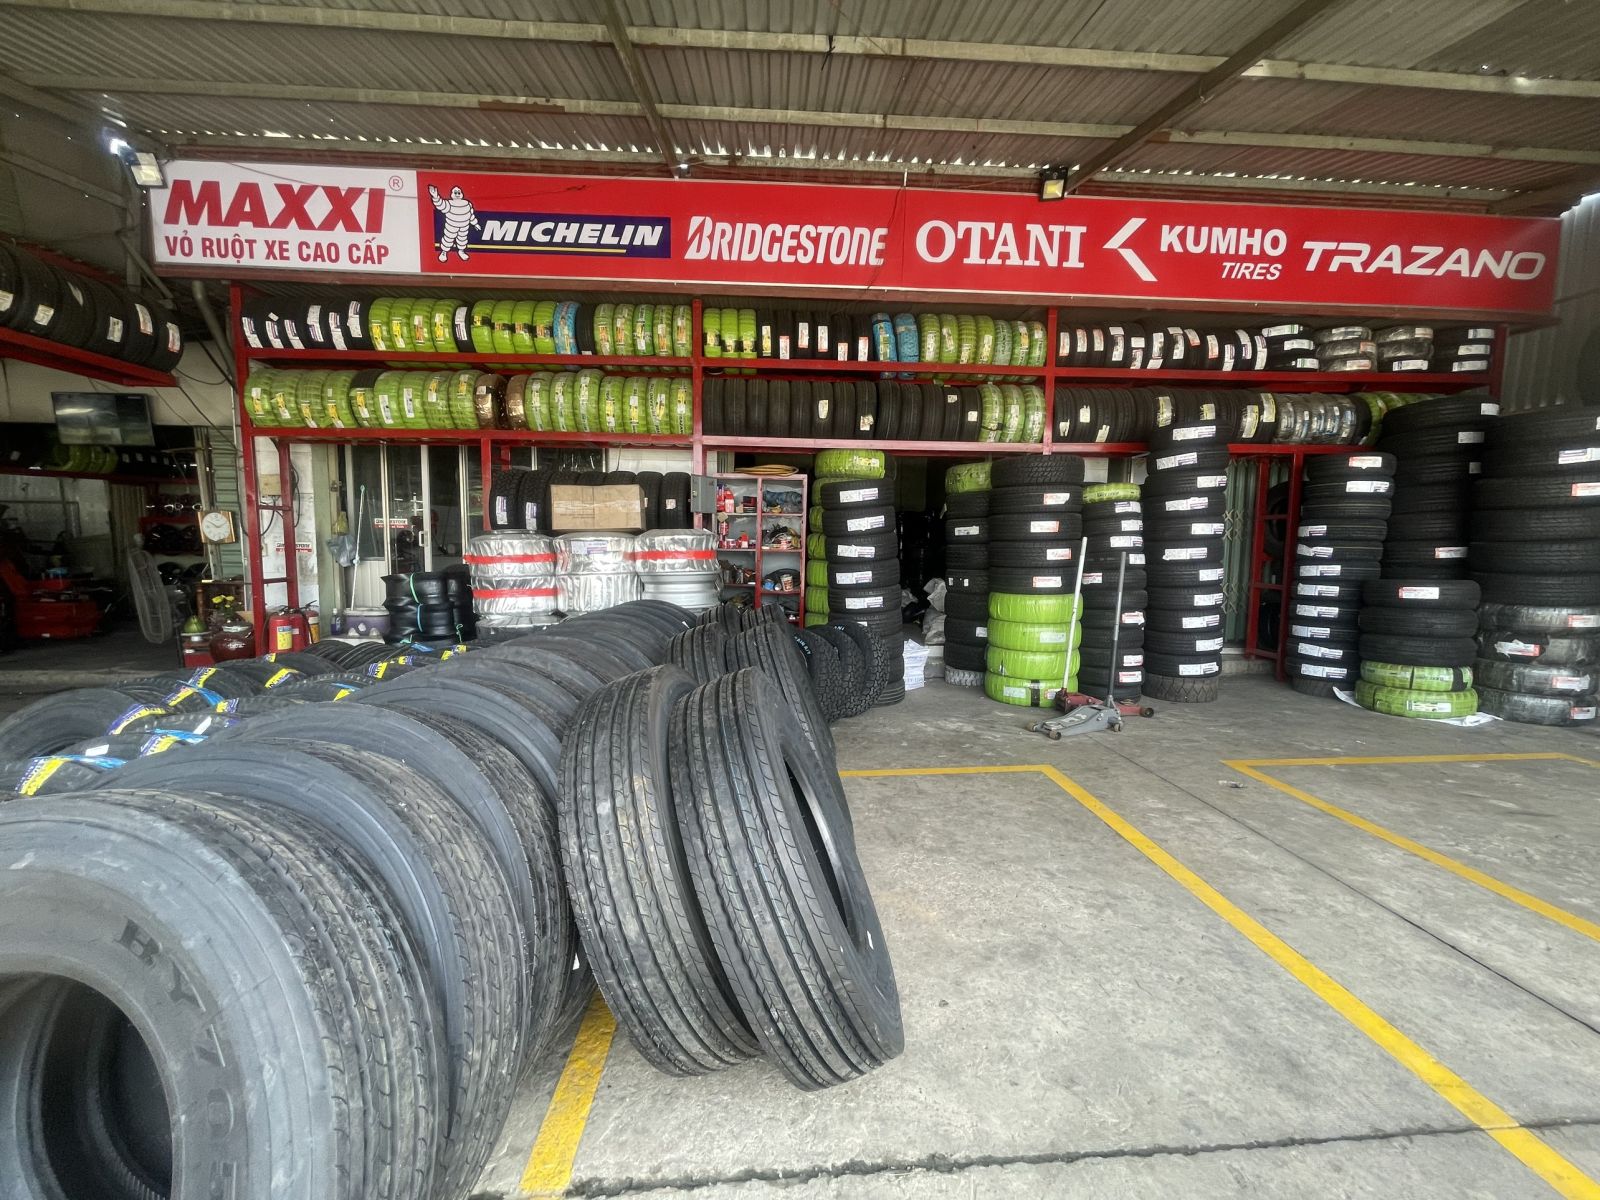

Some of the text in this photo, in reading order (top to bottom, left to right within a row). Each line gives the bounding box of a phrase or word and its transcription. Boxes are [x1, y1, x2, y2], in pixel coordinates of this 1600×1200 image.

[163, 179, 386, 234] MAXXI
[165, 230, 390, 265] VỎ RUỘT XE CAO CẤP
[481, 219, 663, 247] MICHELIN
[684, 215, 889, 266] BRIDGESTONE
[915, 220, 1087, 268] OTANI
[1160, 224, 1288, 257] KUMHO
[1221, 262, 1283, 281] TIRES
[1302, 241, 1546, 281] TRAZANO
